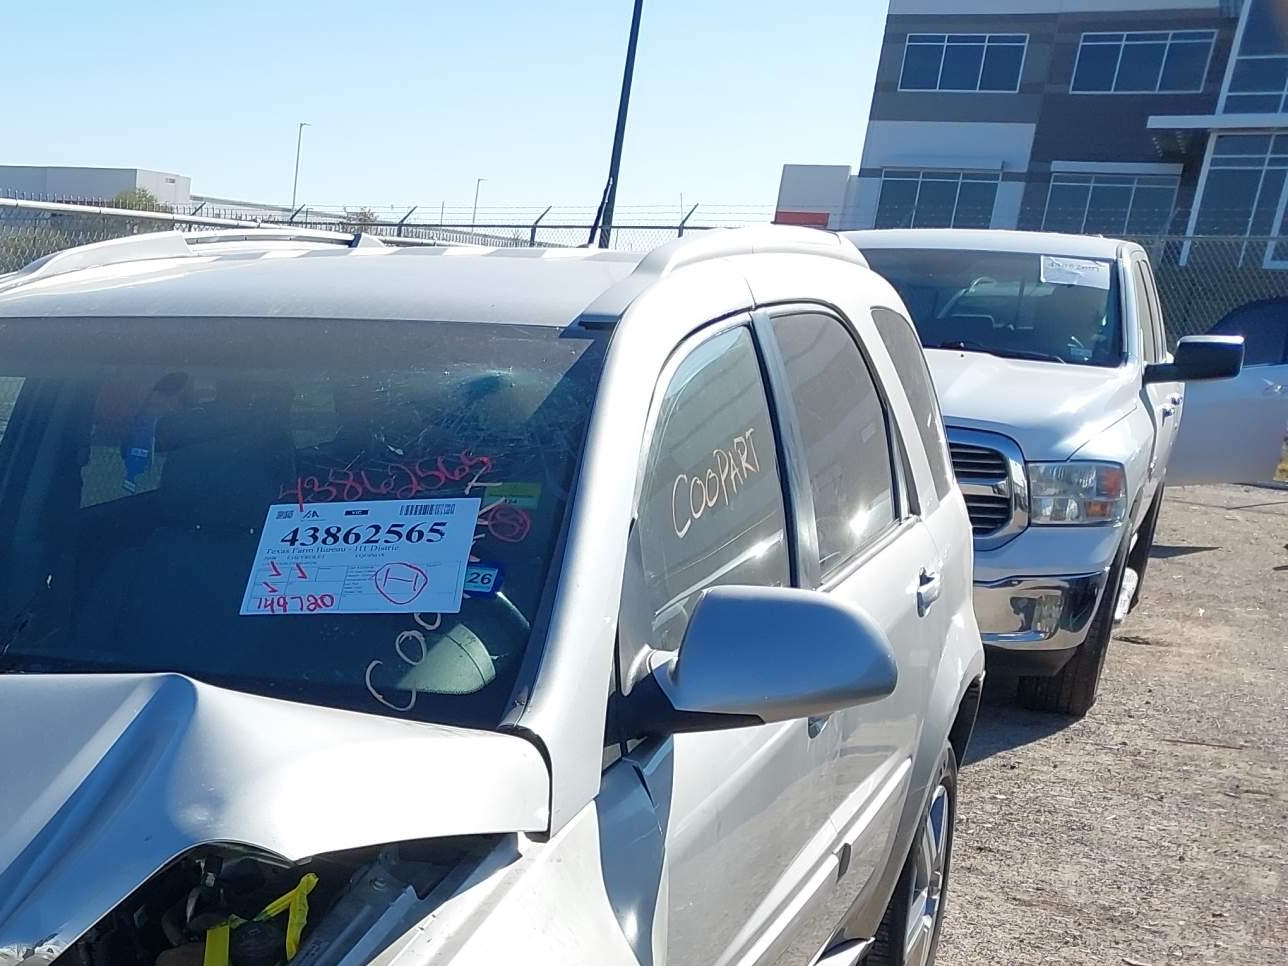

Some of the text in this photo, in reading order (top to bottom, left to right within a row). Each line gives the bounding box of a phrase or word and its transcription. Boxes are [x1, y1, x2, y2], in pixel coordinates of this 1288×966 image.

[672, 427, 760, 539] COOPART
[280, 521, 449, 547] 43862565
[465, 571, 492, 585] 26
